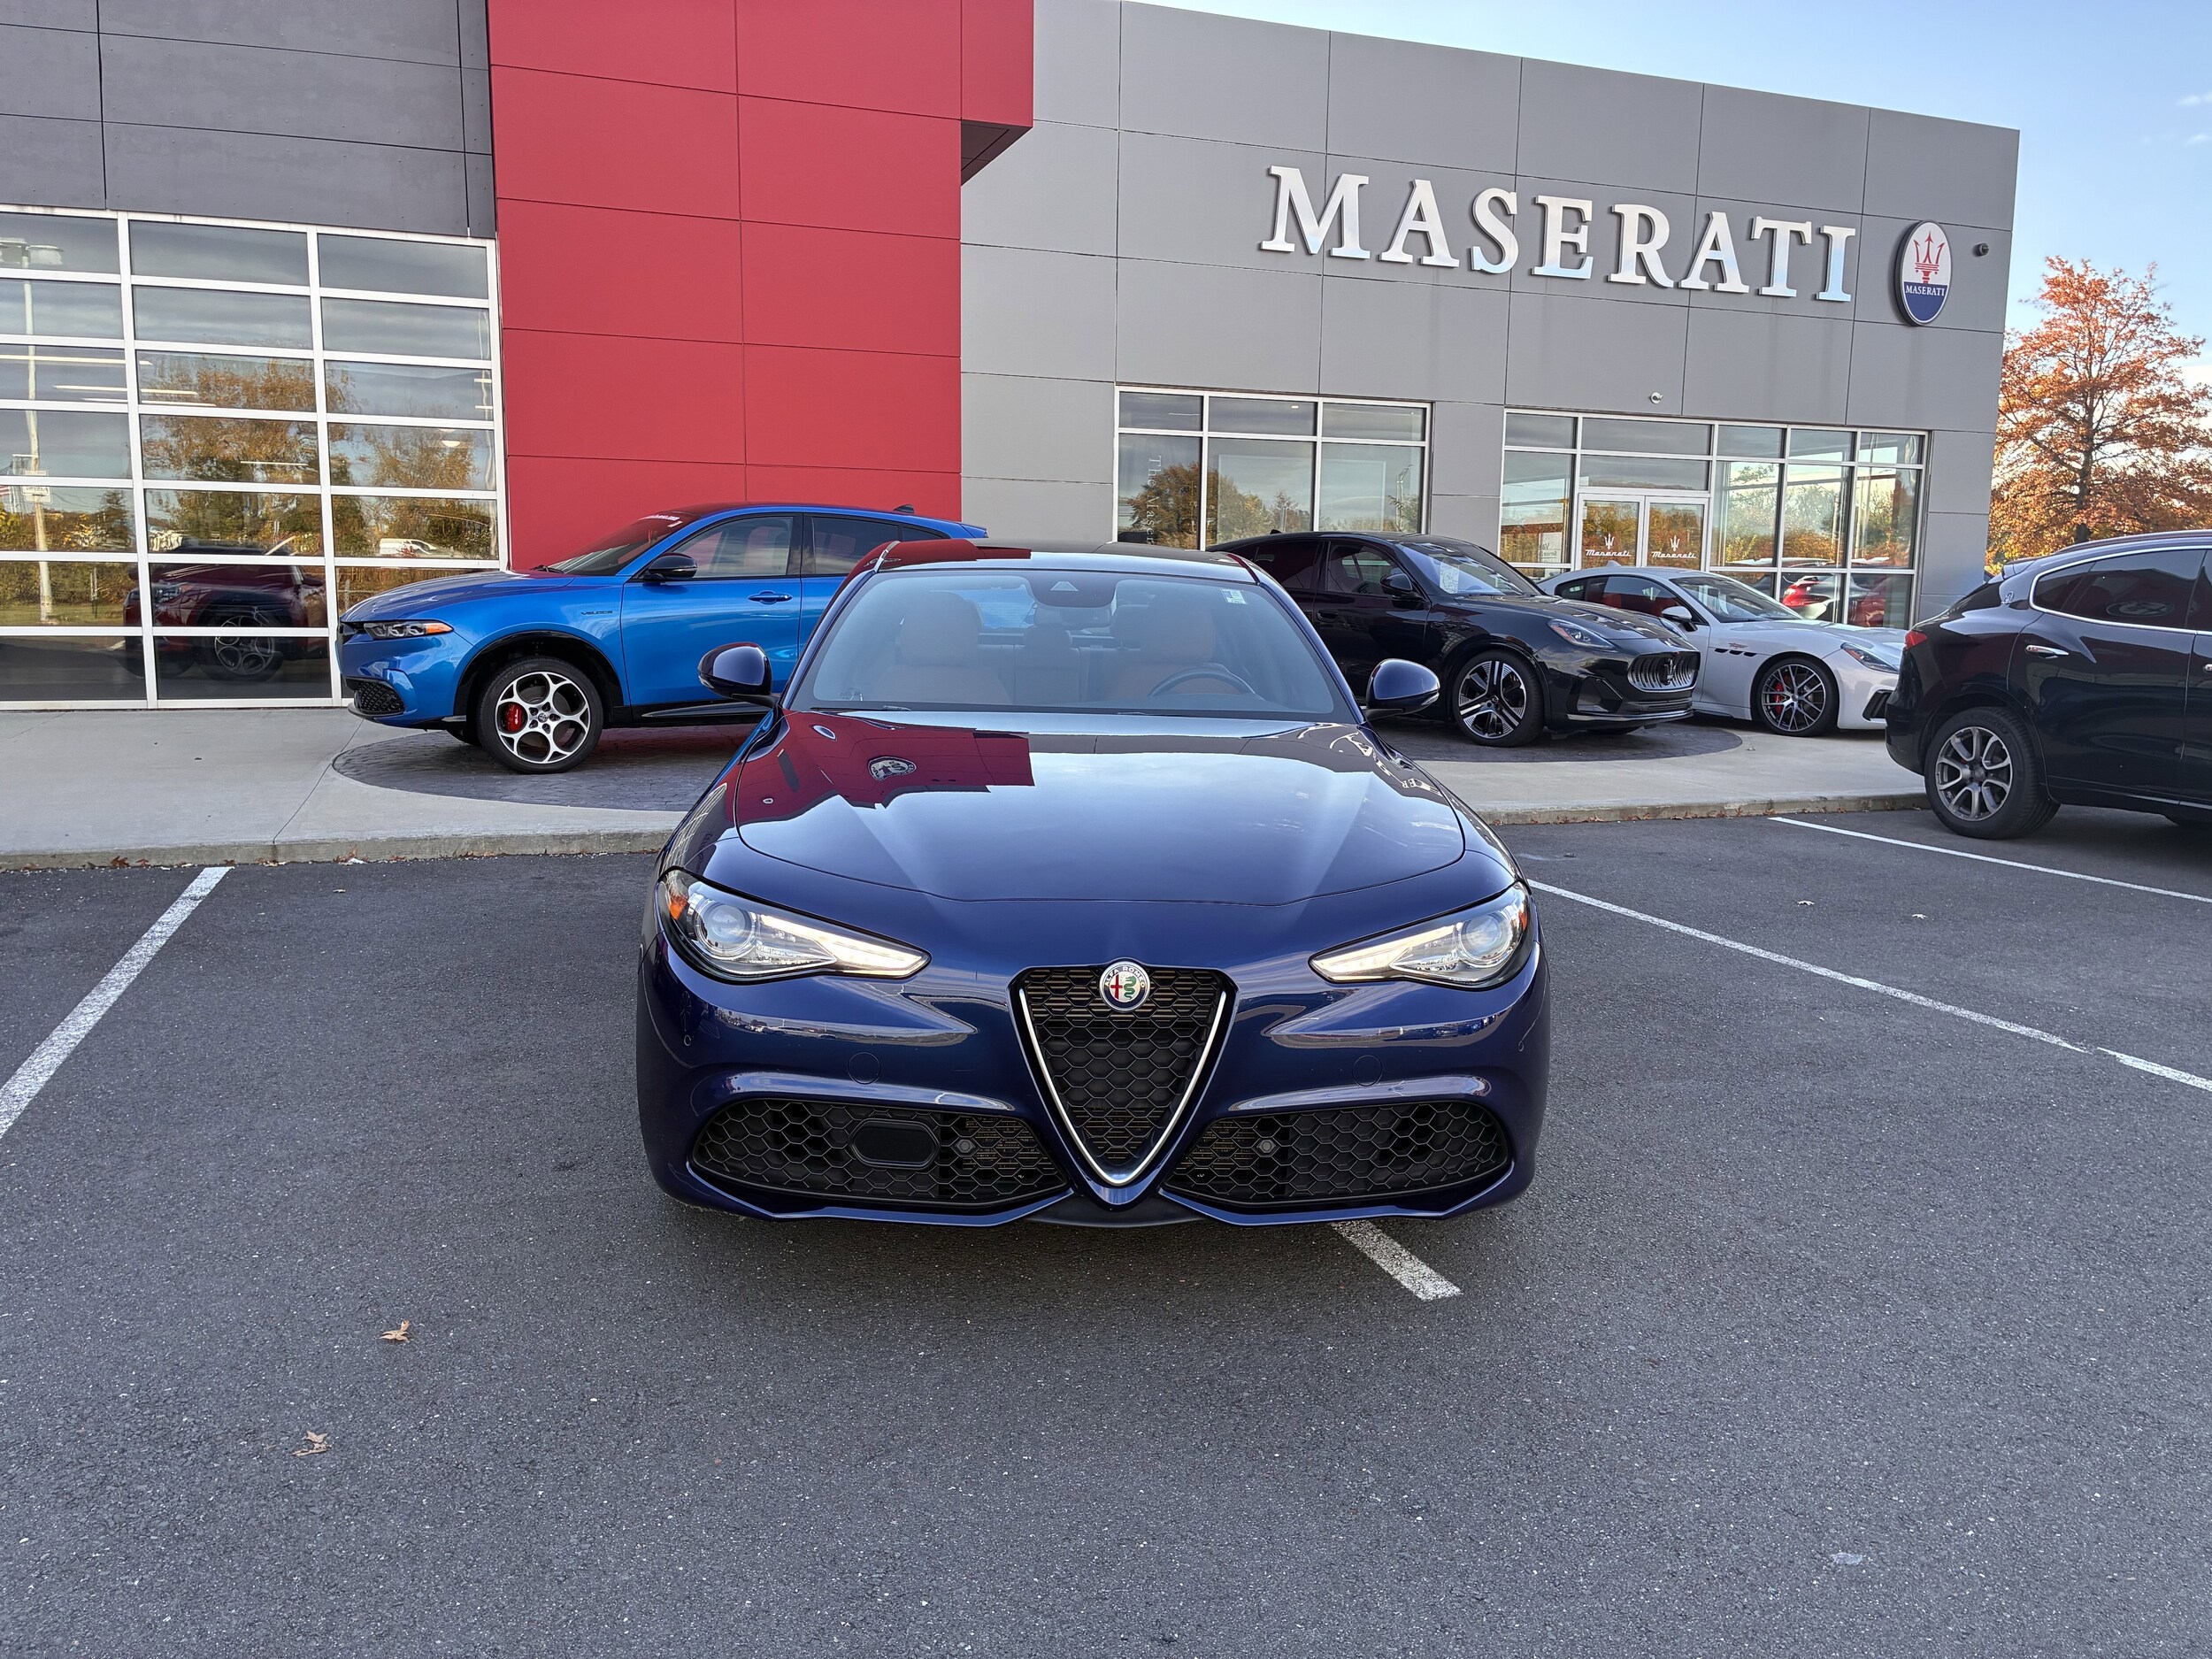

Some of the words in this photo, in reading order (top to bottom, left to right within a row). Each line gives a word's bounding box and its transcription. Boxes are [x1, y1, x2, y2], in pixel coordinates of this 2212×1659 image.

[1260, 165, 1856, 303] MASERATI
[1905, 284, 1946, 296] MASERATI
[1148, 456, 1162, 487] The
[1105, 969, 1119, 987] ALFA
[1123, 966, 1145, 988] ROMEO
